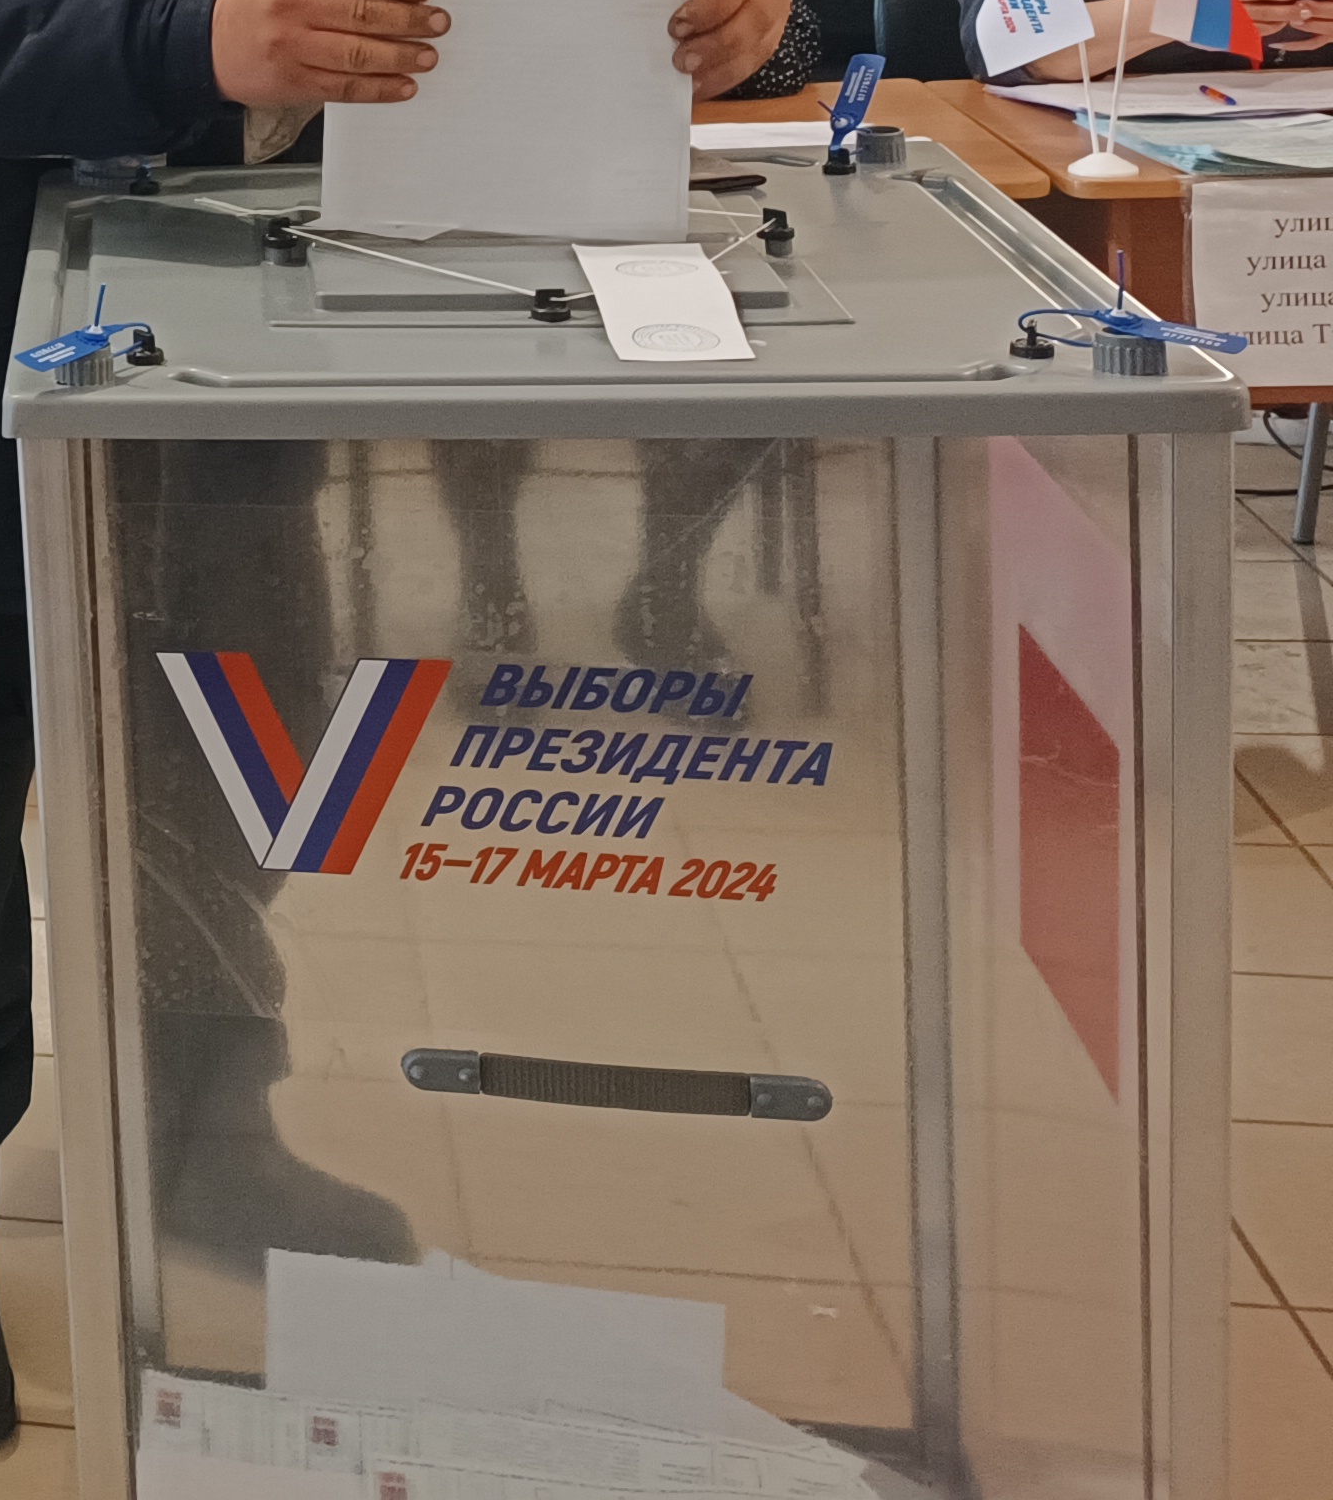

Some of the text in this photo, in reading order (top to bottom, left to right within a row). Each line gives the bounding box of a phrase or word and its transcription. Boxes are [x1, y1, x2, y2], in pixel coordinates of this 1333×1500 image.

[1246, 254, 1326, 276] улица
[1235, 330, 1304, 346] лица
[479, 664, 753, 717] ВЫБОРЫ
[450, 725, 833, 786] ПРЕЗИДЕНТА
[421, 786, 665, 838] РОССИИ
[516, 850, 665, 895] МАРТА
[668, 858, 777, 901] 2024
